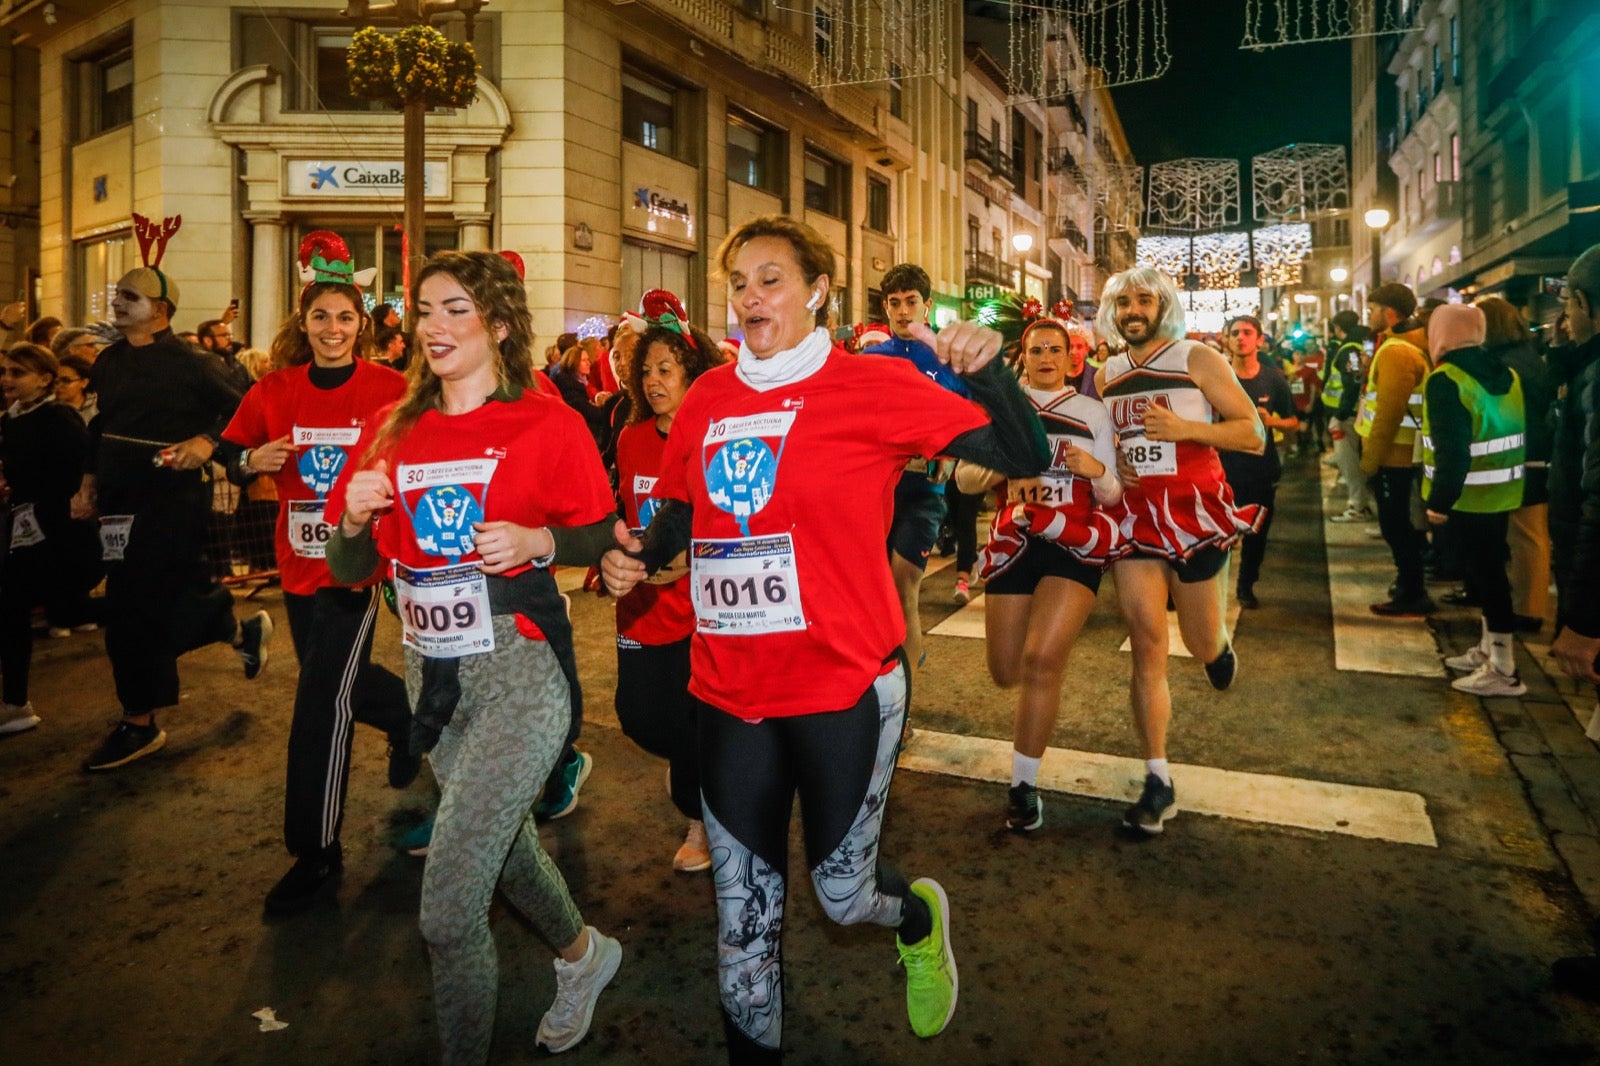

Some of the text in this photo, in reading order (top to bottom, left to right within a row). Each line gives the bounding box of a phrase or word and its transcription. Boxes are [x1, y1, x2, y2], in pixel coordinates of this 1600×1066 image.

[343, 167, 427, 184] CaixaBa
[968, 286, 994, 299] 16H
[300, 431, 313, 441] 30
[711, 423, 726, 438] 30
[406, 469, 424, 484] 30
[638, 479, 650, 490] 30
[704, 575, 787, 607] 1016
[404, 601, 476, 632] 1009
